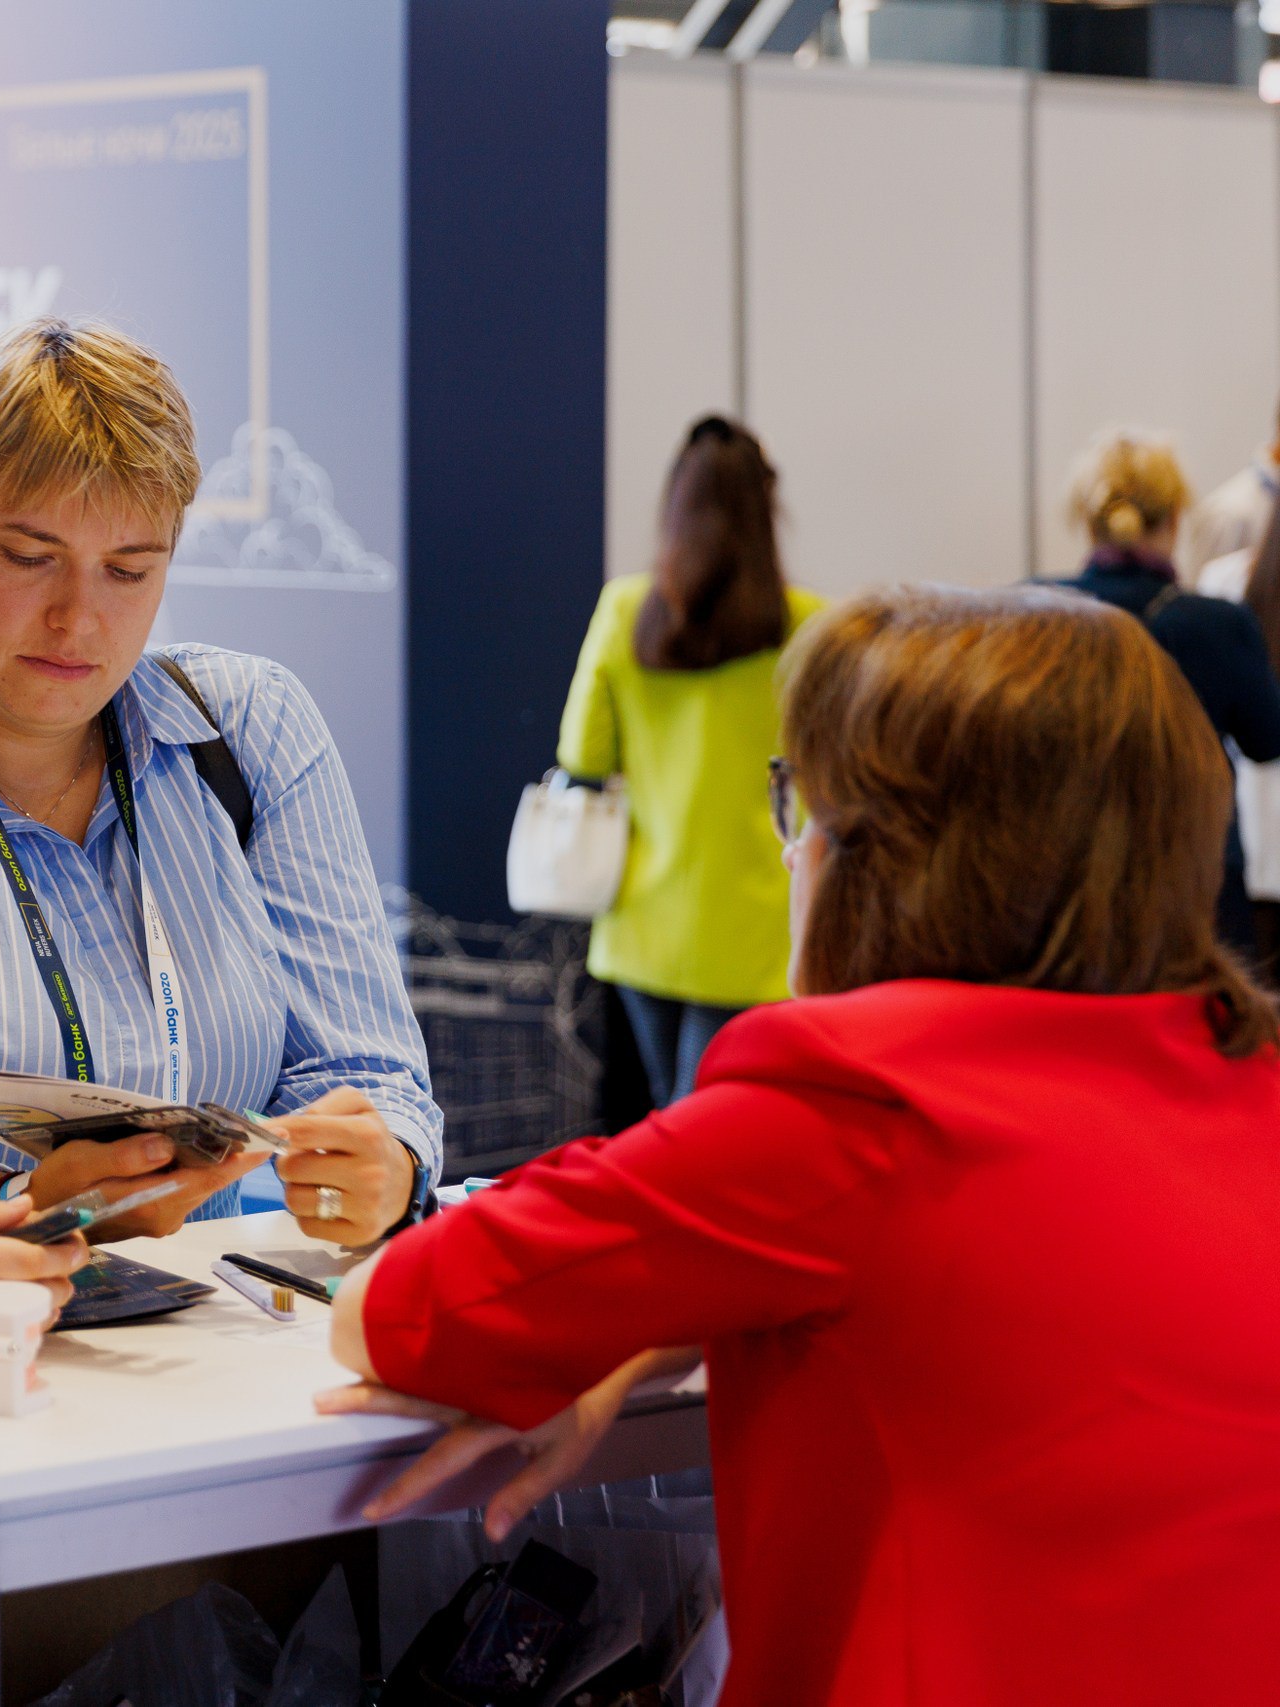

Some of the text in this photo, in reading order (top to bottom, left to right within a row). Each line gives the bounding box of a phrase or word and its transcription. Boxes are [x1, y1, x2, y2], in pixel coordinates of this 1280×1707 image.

[9, 861, 27, 892] ozon
[160, 972, 174, 1005] ozon
[70, 1023, 86, 1061] банк
[166, 1007, 179, 1046] банк
[77, 1063, 88, 1083] on
